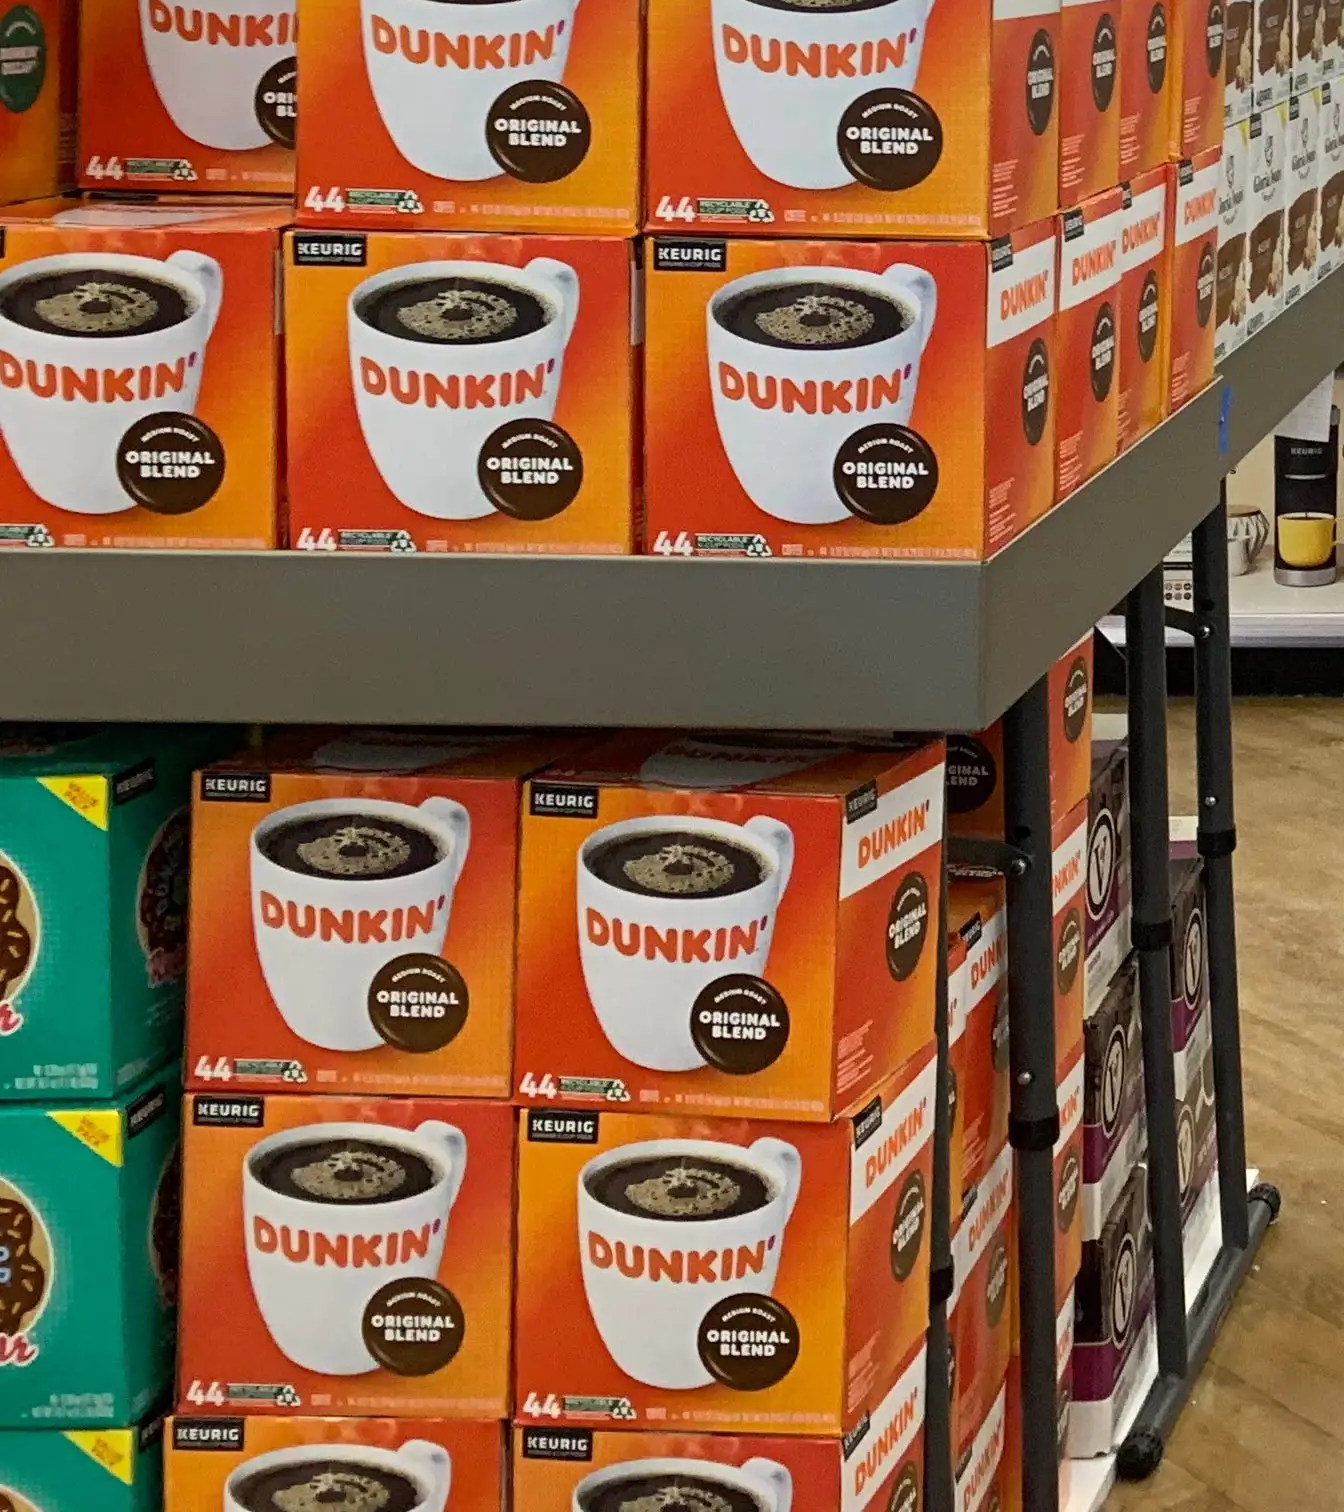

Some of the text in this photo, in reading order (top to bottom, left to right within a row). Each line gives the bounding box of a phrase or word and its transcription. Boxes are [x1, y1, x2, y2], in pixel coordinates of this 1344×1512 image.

[372, 14, 565, 69] DUNKIN'
[721, 24, 916, 78] DUNKIN'
[494, 119, 581, 135] ORIGINAL
[845, 127, 932, 141] ORIGINAL
[508, 132, 567, 148] BLEND
[860, 140, 918, 155] BLEND
[86, 156, 122, 180] 44
[304, 187, 344, 212] 44
[656, 196, 694, 222] 44
[298, 243, 362, 257] KEURIG
[658, 247, 721, 261] KEURIG
[1000, 270, 1049, 321] DUNKIN'
[360, 356, 554, 408] DUNKIN'
[717, 362, 912, 416] DUNKIN'
[125, 450, 215, 466] ORIGINAL
[486, 457, 573, 471] ORIGINAL
[140, 463, 200, 478] BLEND
[842, 461, 928, 475] ORIGINAL
[500, 470, 559, 484] BLEND
[856, 474, 914, 488] BLEND
[297, 528, 336, 551] 44
[653, 531, 692, 556] 44
[205, 779, 266, 794] KEURIG
[535, 793, 595, 809] KEURIG
[857, 799, 931, 868] DUNKIN'
[260, 889, 444, 944] DUNKIN'
[586, 907, 767, 963] DUNKIN'
[377, 991, 458, 1007] ORIGINAL
[389, 1005, 445, 1019] BLEND
[700, 1011, 780, 1028] ORIGINAL
[711, 1025, 765, 1040] BLEND
[195, 1057, 231, 1081] 44
[520, 1072, 556, 1099] 44
[198, 1103, 260, 1118] KEURIG
[533, 1119, 594, 1136] KEURIG
[864, 1095, 927, 1188] DUNKIN'
[252, 1215, 439, 1268] DUNKIN'
[588, 1234, 776, 1284] DUNKIN'
[371, 1315, 454, 1330] ORIGINAL
[385, 1327, 440, 1342] BLEND
[707, 1332, 790, 1346] ORIGINAL
[720, 1343, 776, 1356] BLEND
[186, 1380, 223, 1405] 44
[522, 1392, 561, 1419] 44
[177, 1428, 238, 1443] KEURIG
[853, 1387, 919, 1497] DUNKIN'
[527, 1437, 588, 1452] KEURIG
